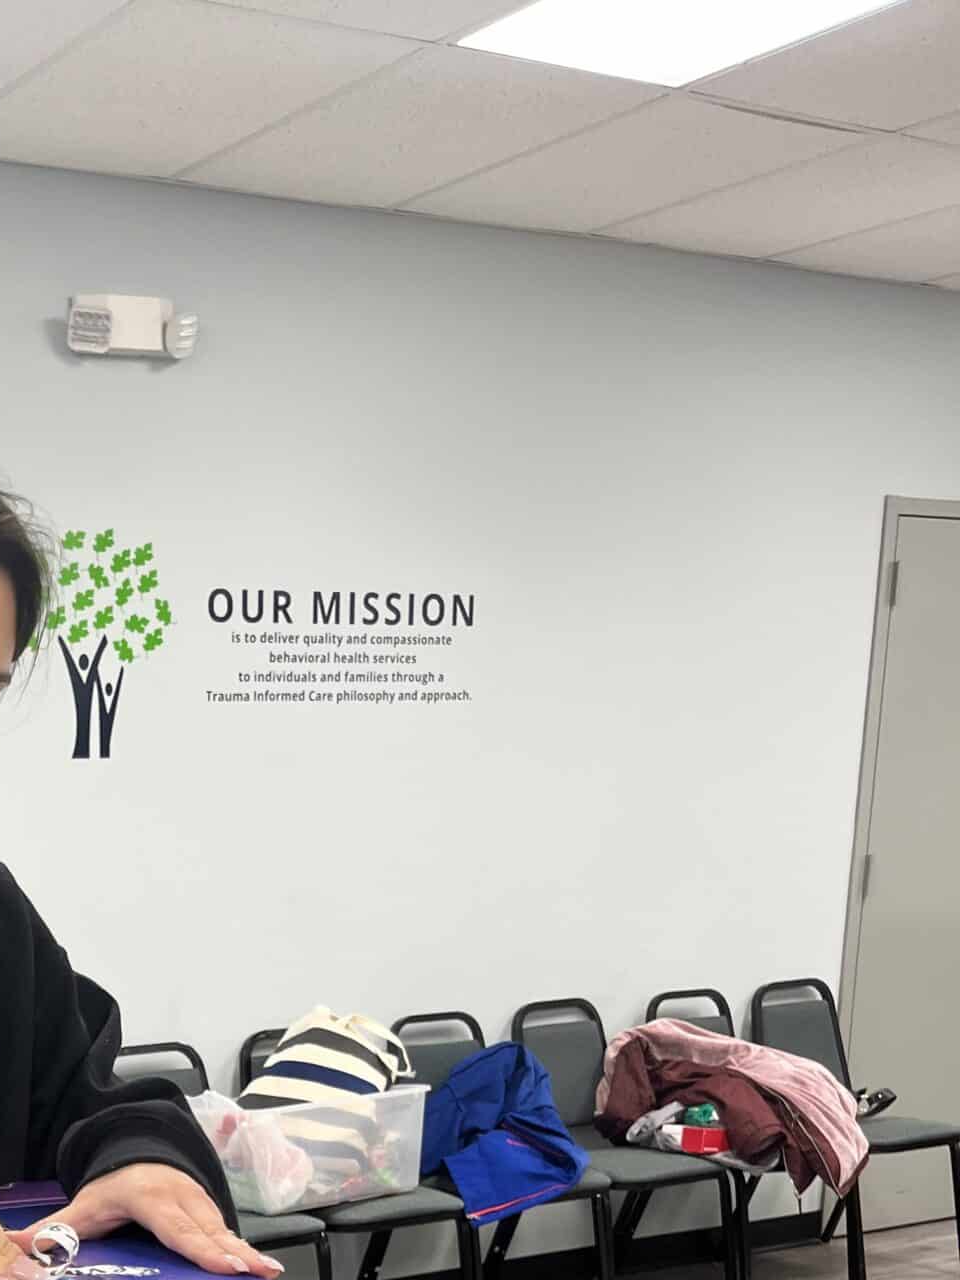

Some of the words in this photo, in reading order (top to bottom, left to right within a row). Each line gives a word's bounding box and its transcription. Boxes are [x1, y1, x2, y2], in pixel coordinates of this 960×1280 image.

[207, 587, 294, 625] OUR
[312, 590, 476, 627] MISSION
[231, 631, 241, 644] is
[244, 632, 257, 644] to
[259, 631, 300, 644] deliver
[303, 632, 344, 648] quality
[346, 633, 367, 645] and
[369, 634, 453, 648] compassionate
[269, 651, 331, 664] behavioral
[333, 651, 370, 664] health
[373, 653, 417, 665] services
[238, 672, 251, 683] to
[253, 671, 317, 683] individuals
[319, 671, 341, 683] and
[344, 671, 389, 683] families
[391, 671, 435, 686] through
[437, 673, 445, 683] a
[206, 690, 250, 702] Trauma
[253, 689, 306, 702] Informed
[308, 690, 334, 702] Care
[336, 689, 396, 705] philosophy
[397, 690, 418, 701] and
[420, 690, 472, 704] approach.
